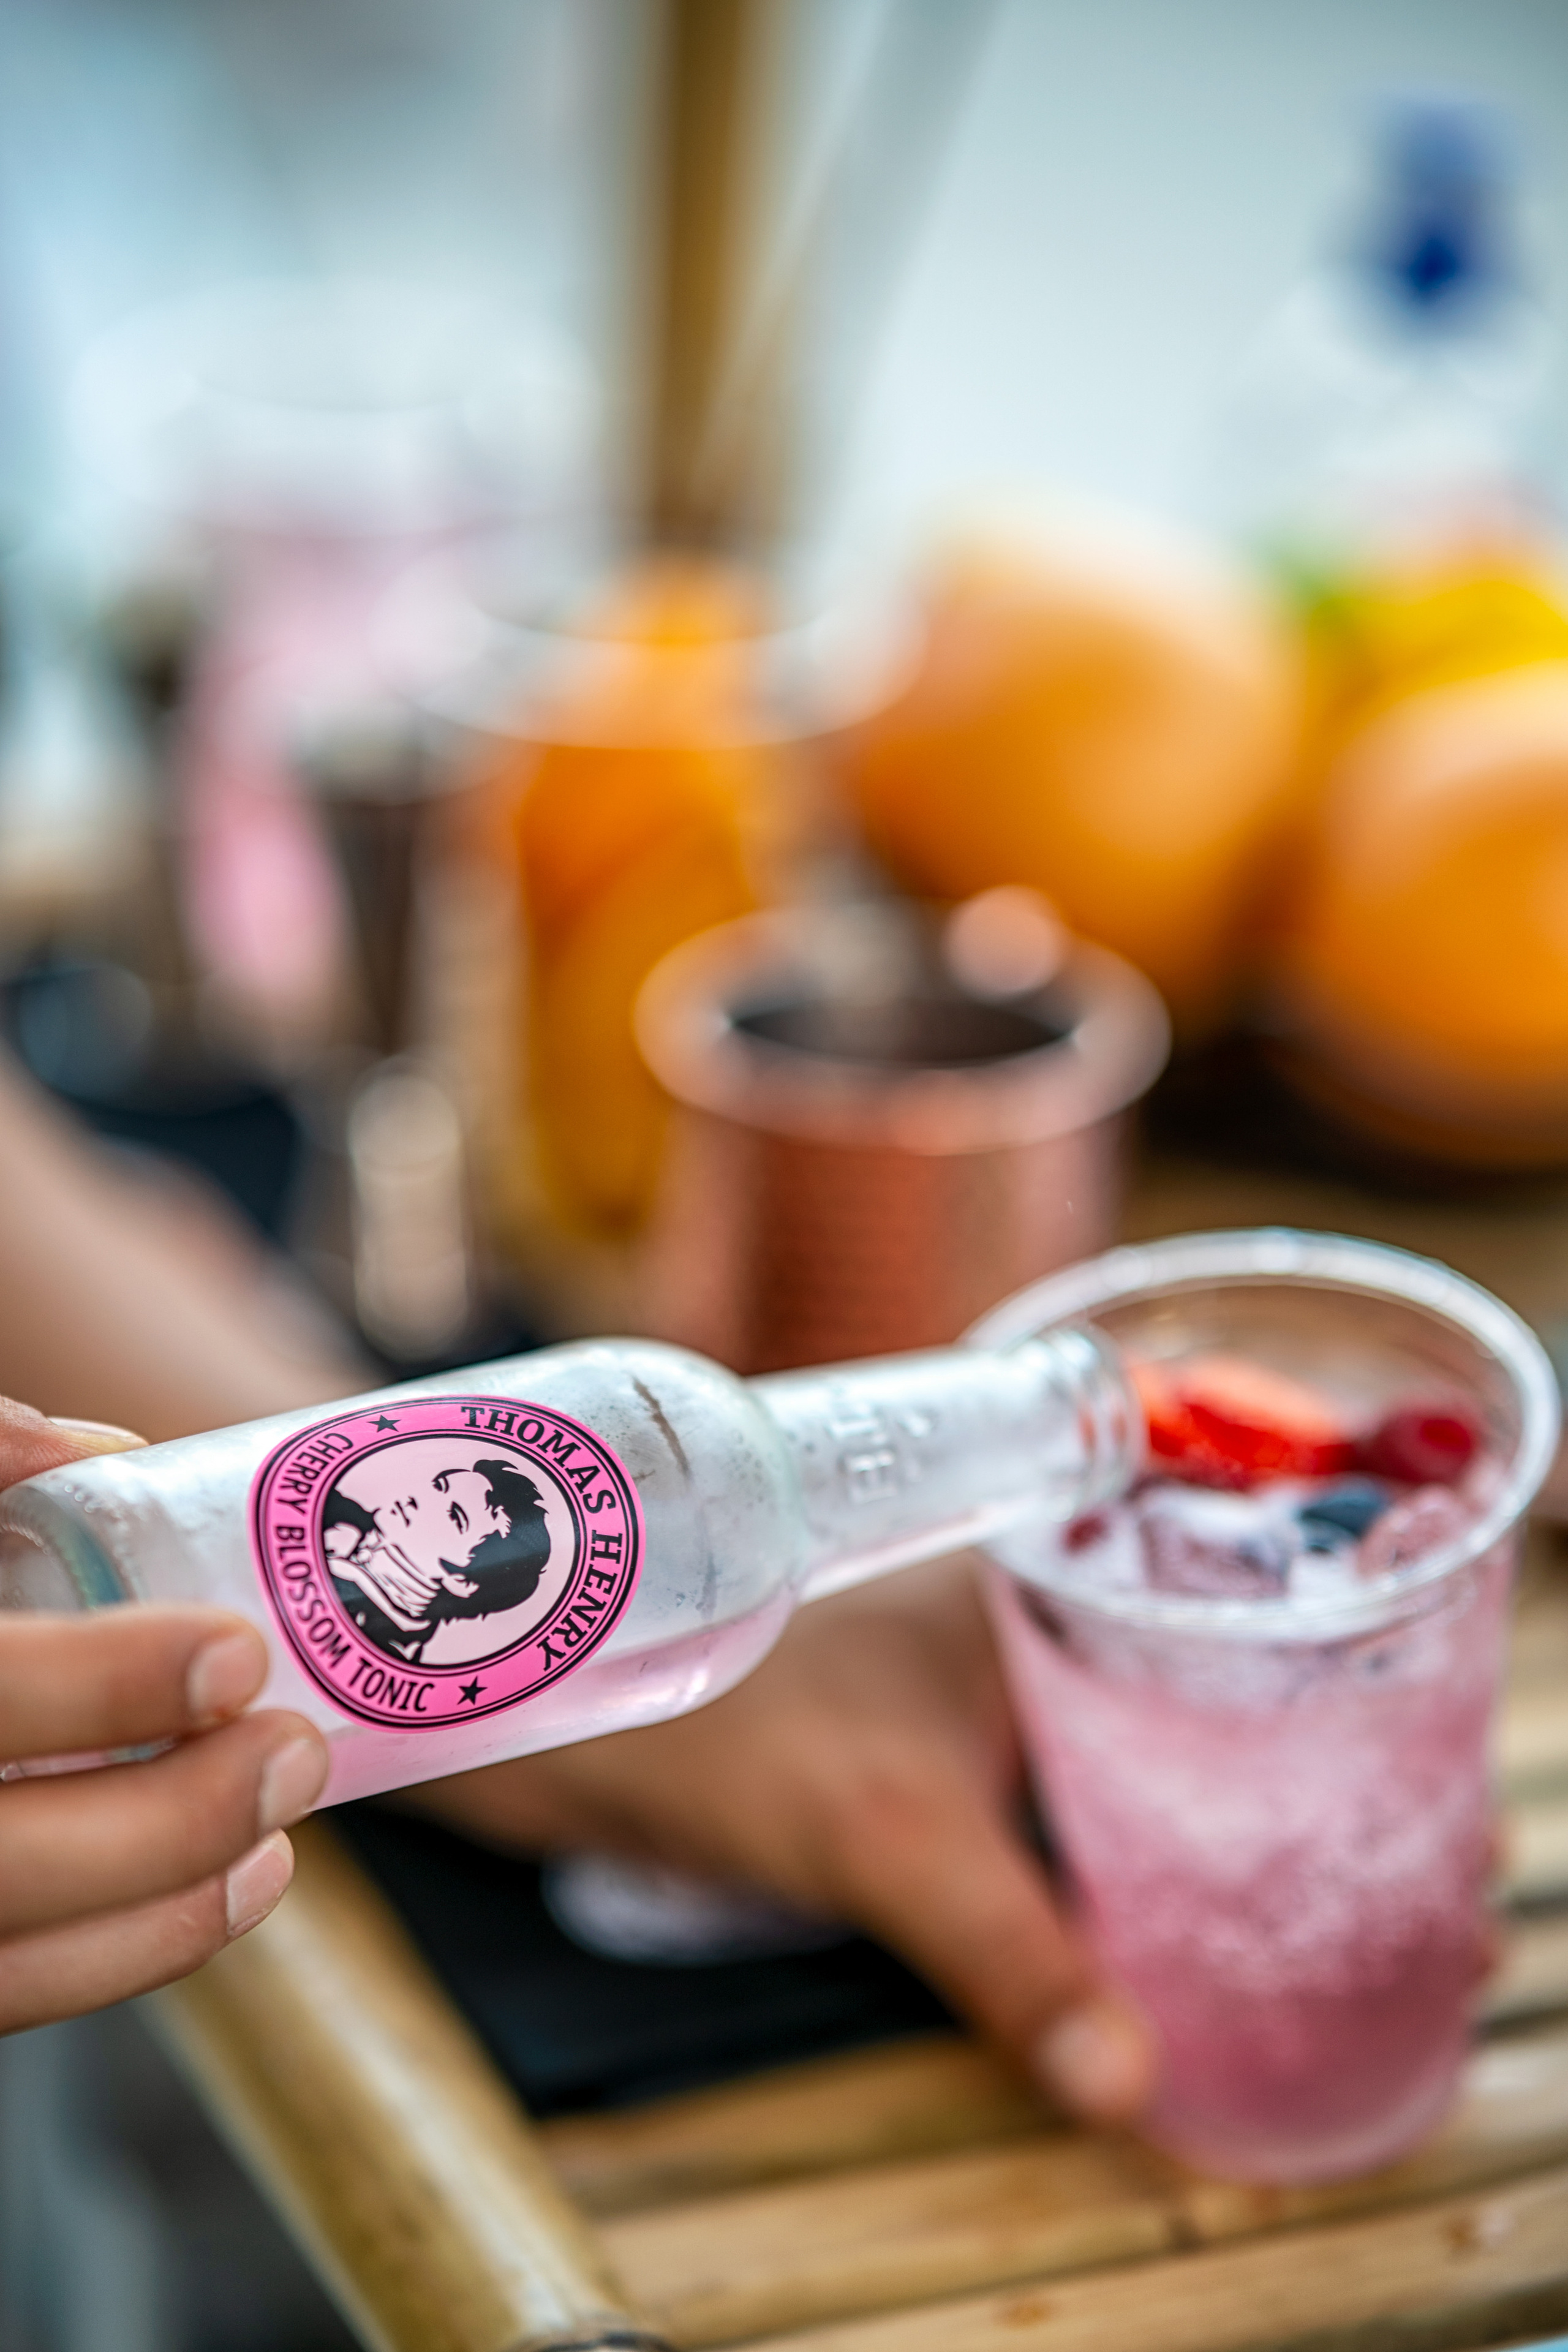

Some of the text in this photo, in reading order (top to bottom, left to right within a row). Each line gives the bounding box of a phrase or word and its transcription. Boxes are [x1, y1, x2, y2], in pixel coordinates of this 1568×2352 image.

[274, 1433, 435, 1712] CHERRY BLOSSOM TONIC
[461, 1406, 623, 1671] THOMAS HENRY
